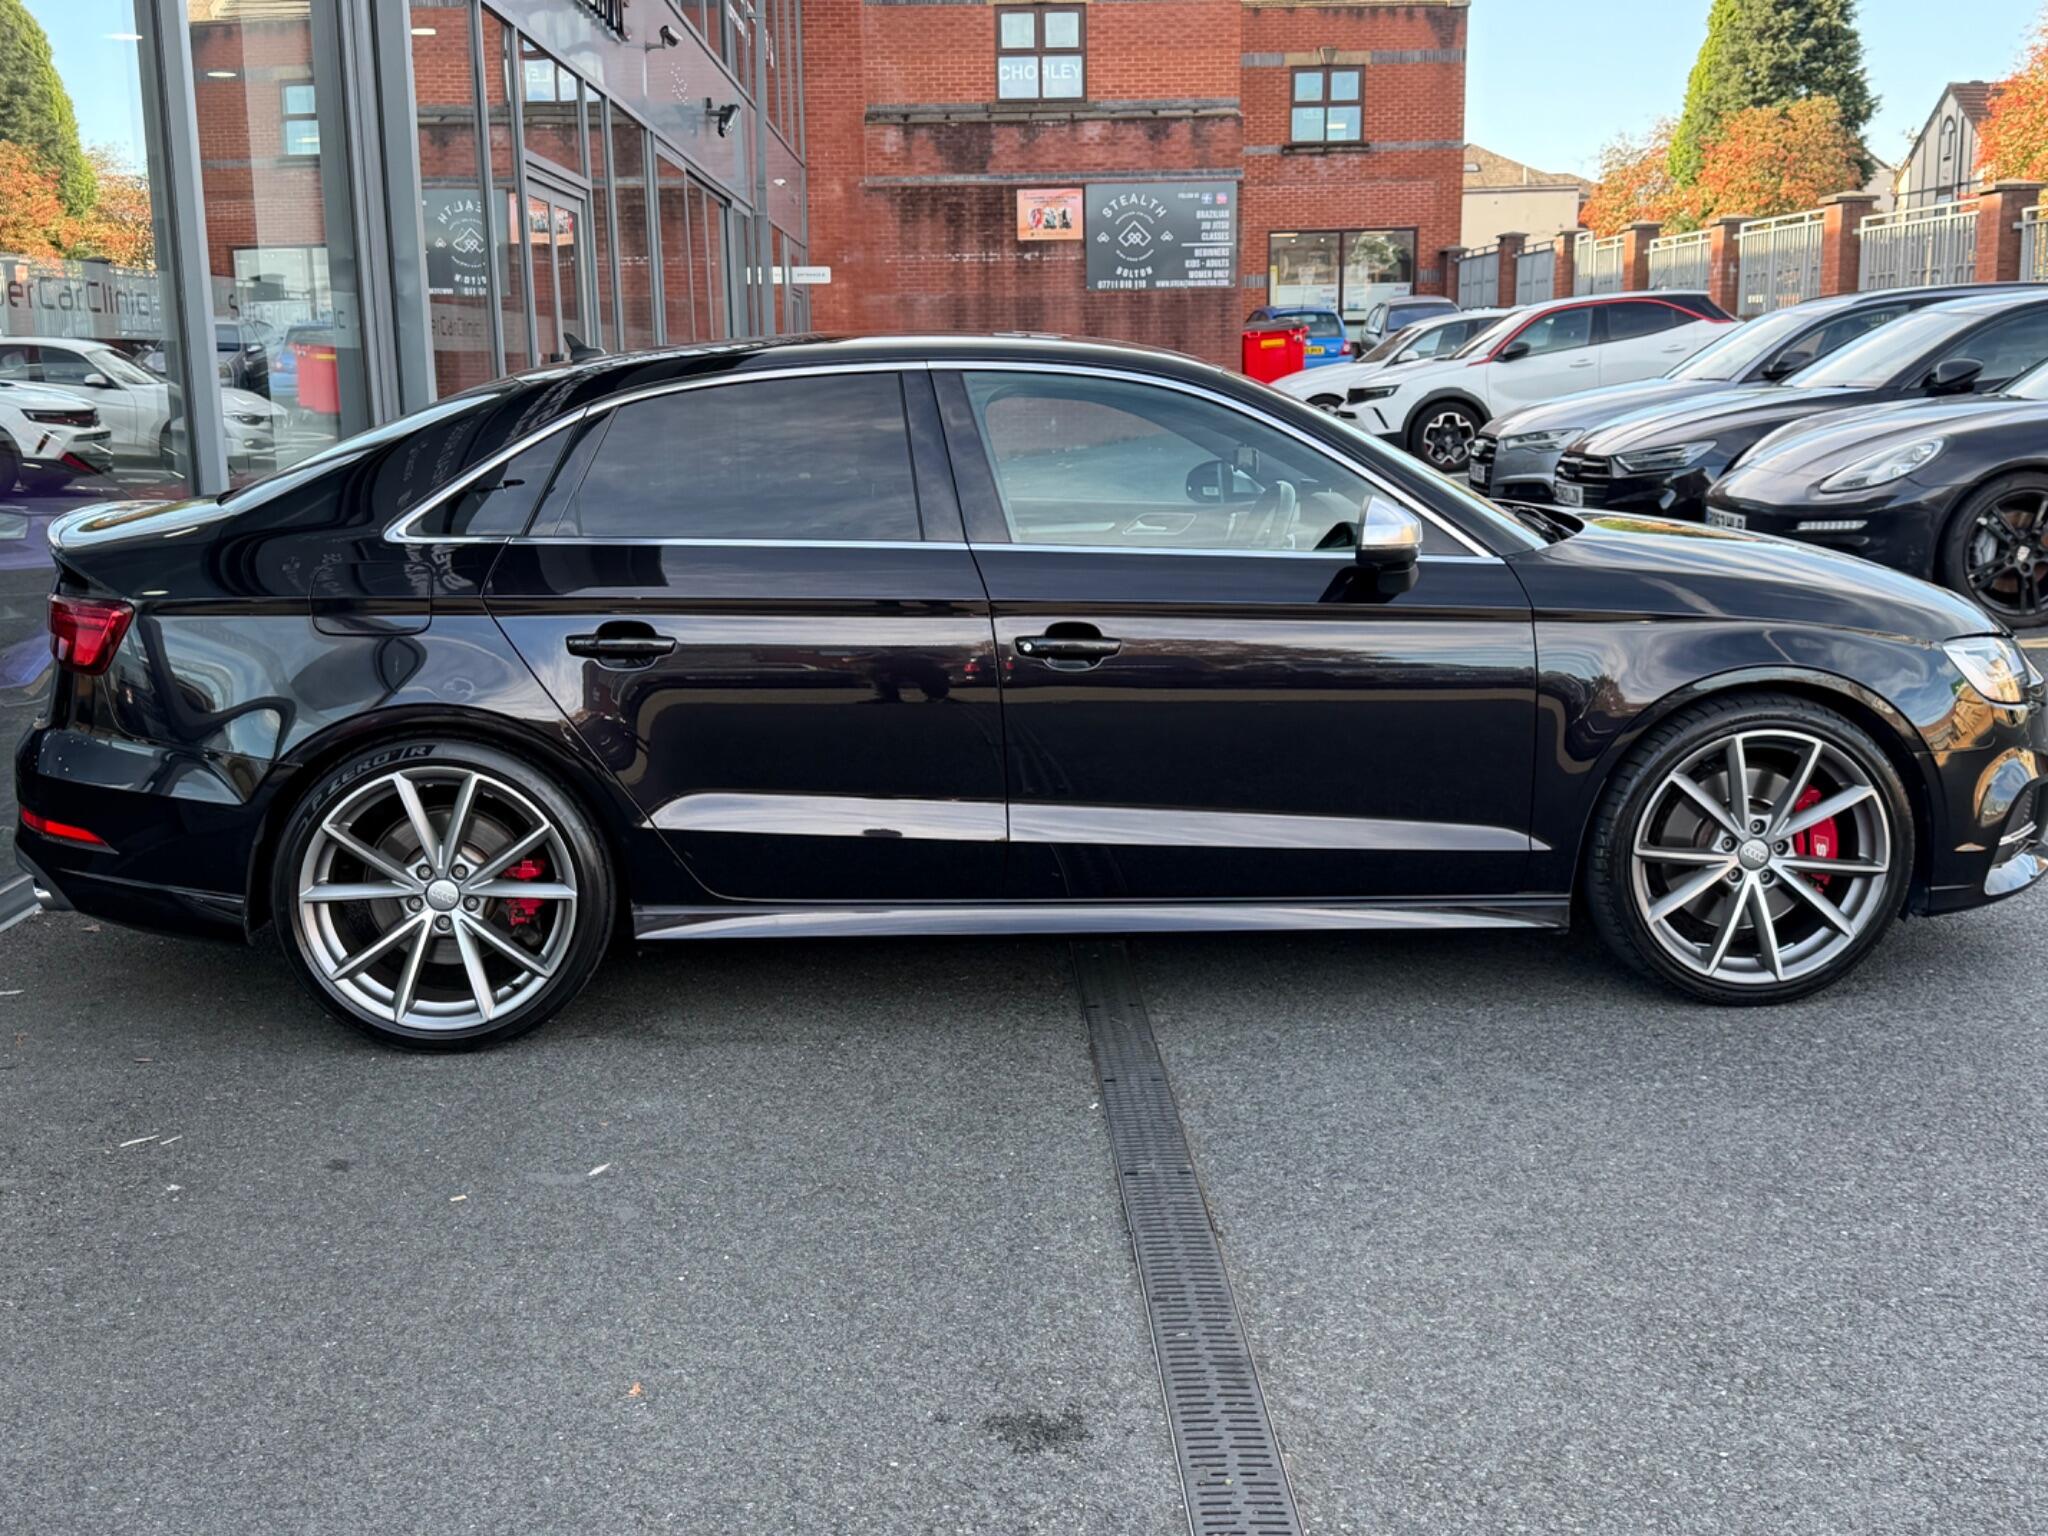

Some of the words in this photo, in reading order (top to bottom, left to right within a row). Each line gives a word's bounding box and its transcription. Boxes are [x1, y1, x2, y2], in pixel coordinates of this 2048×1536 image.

[1102, 193, 1167, 218] STEALTH
[1196, 210, 1230, 219] BRAZILIAN
[1201, 232, 1230, 241] CLASSES
[1194, 248, 1230, 257] BEGINNERS
[1185, 259, 1200, 268] KIDS
[1205, 258, 1230, 268] ADULTS
[1116, 266, 1153, 279] BOLTON
[1188, 270, 1212, 279] WOMEN
[1213, 270, 1229, 279] ONLY
